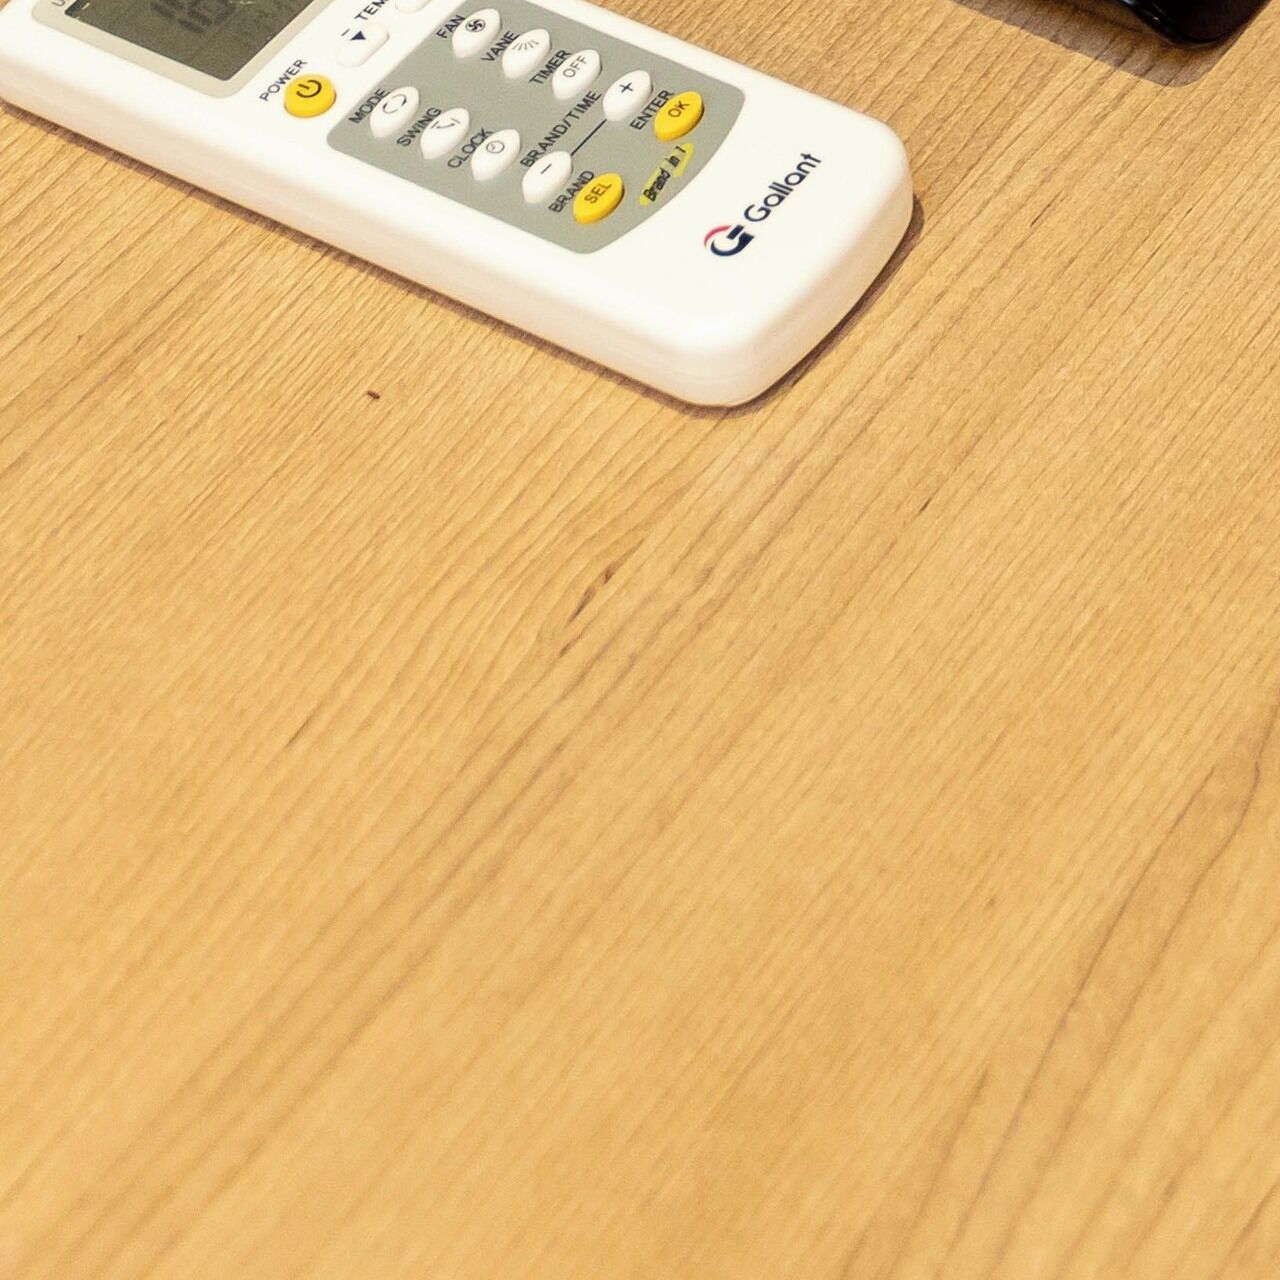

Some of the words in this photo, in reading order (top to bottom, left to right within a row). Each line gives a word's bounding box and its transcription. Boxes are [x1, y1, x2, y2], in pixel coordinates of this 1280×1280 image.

[436, 14, 466, 39] FAN
[480, 30, 520, 62] VANE
[259, 59, 307, 101] POWER
[529, 49, 572, 84] TIMER
[562, 55, 587, 78] OFF
[348, 88, 390, 124] MODE
[629, 90, 675, 130] ENTER
[667, 99, 691, 118] OK
[396, 107, 442, 147] SWING
[519, 90, 602, 167] BRAND/TIME
[447, 127, 494, 169] CLOCK
[548, 170, 596, 213] BRAND
[583, 181, 613, 204] SEL
[642, 167, 671, 202] Brand
[743, 153, 822, 223] Gallant
